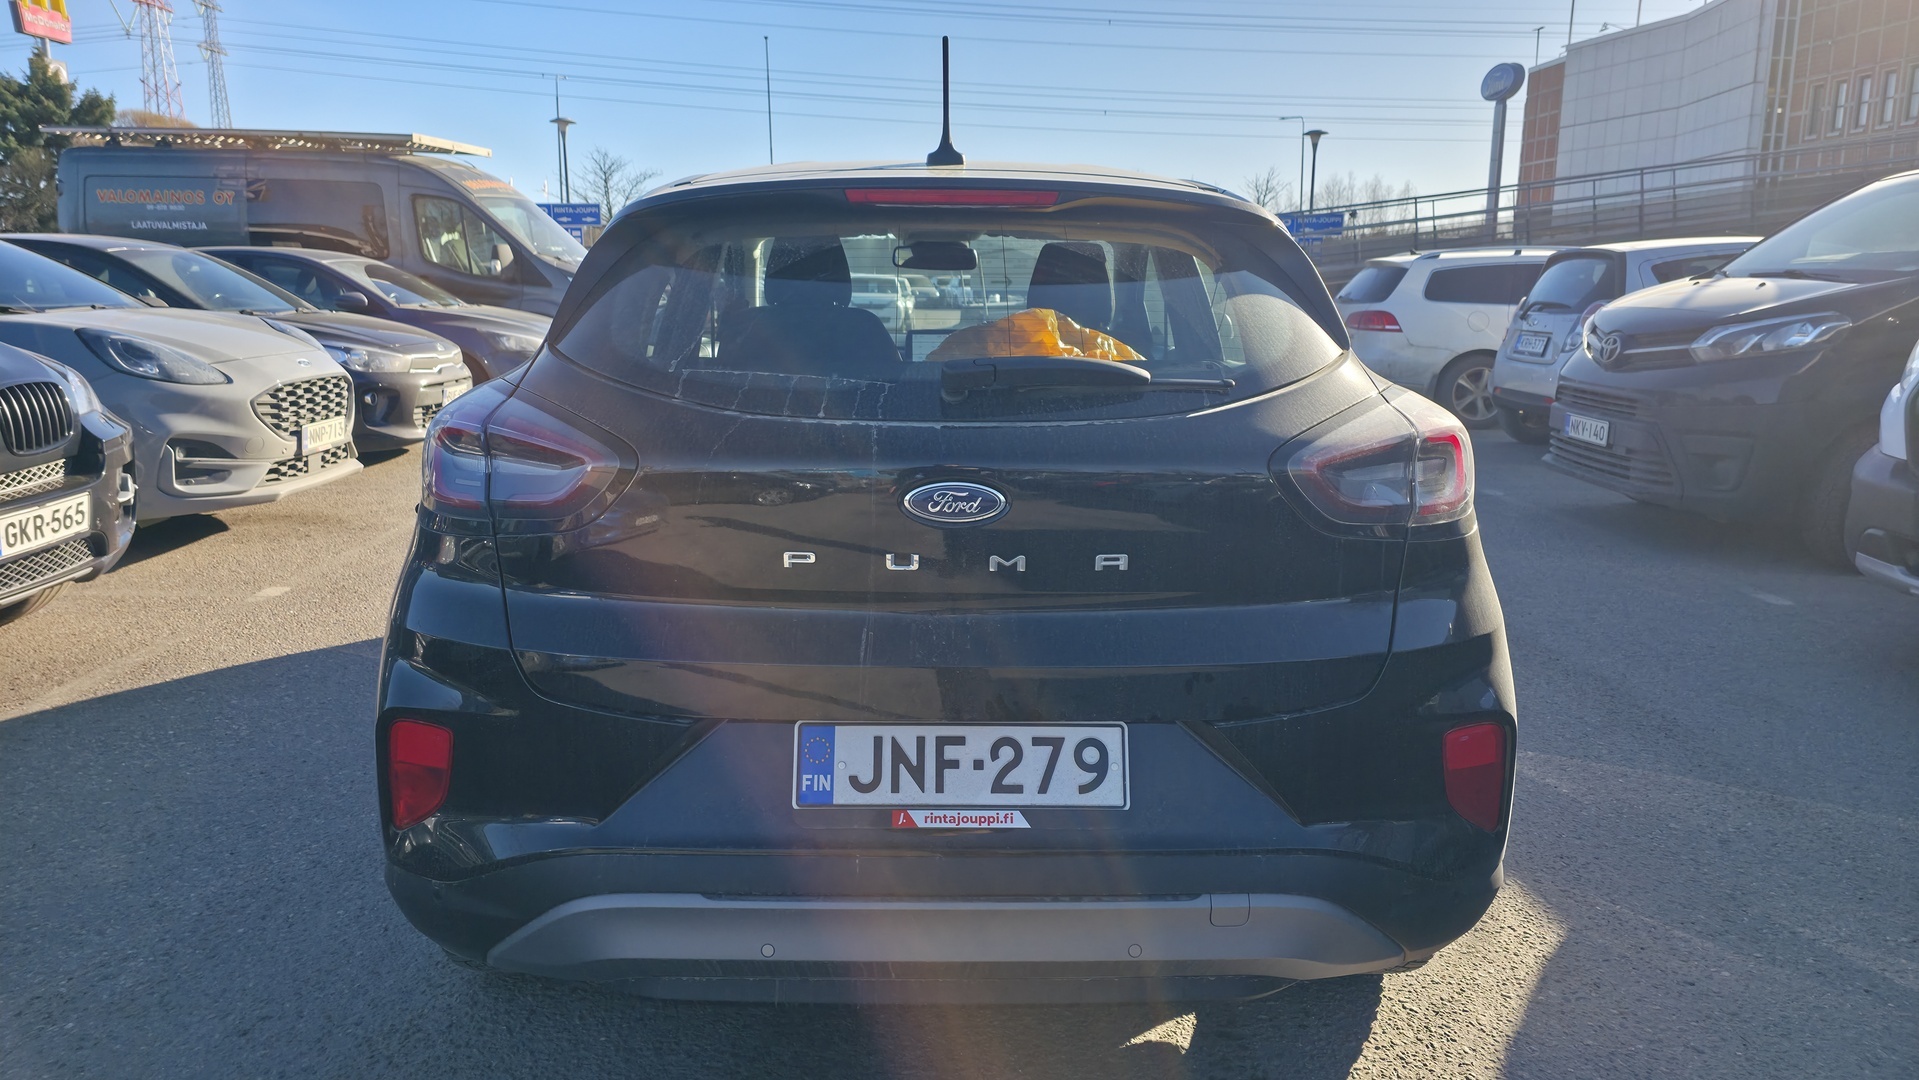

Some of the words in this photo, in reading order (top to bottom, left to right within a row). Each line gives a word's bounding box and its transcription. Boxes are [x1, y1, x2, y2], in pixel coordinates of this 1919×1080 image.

[97, 189, 206, 205] VALOMAINOS
[213, 190, 236, 206] OY
[553, 206, 599, 214] RINTA-JOUPPI
[131, 220, 208, 231] LAATUVALMISTAJA
[1297, 216, 1342, 224] RNTA-JOUPPI
[309, 421, 344, 446] NNP-713
[1570, 418, 1605, 441] NKY-140
[927, 490, 982, 513] Ford
[4, 501, 86, 548] GKR-565
[783, 551, 1129, 572] PUMA
[848, 735, 1109, 794] JNF-279
[801, 774, 831, 792] FIN
[924, 812, 1014, 826] rintajouppi.fi
